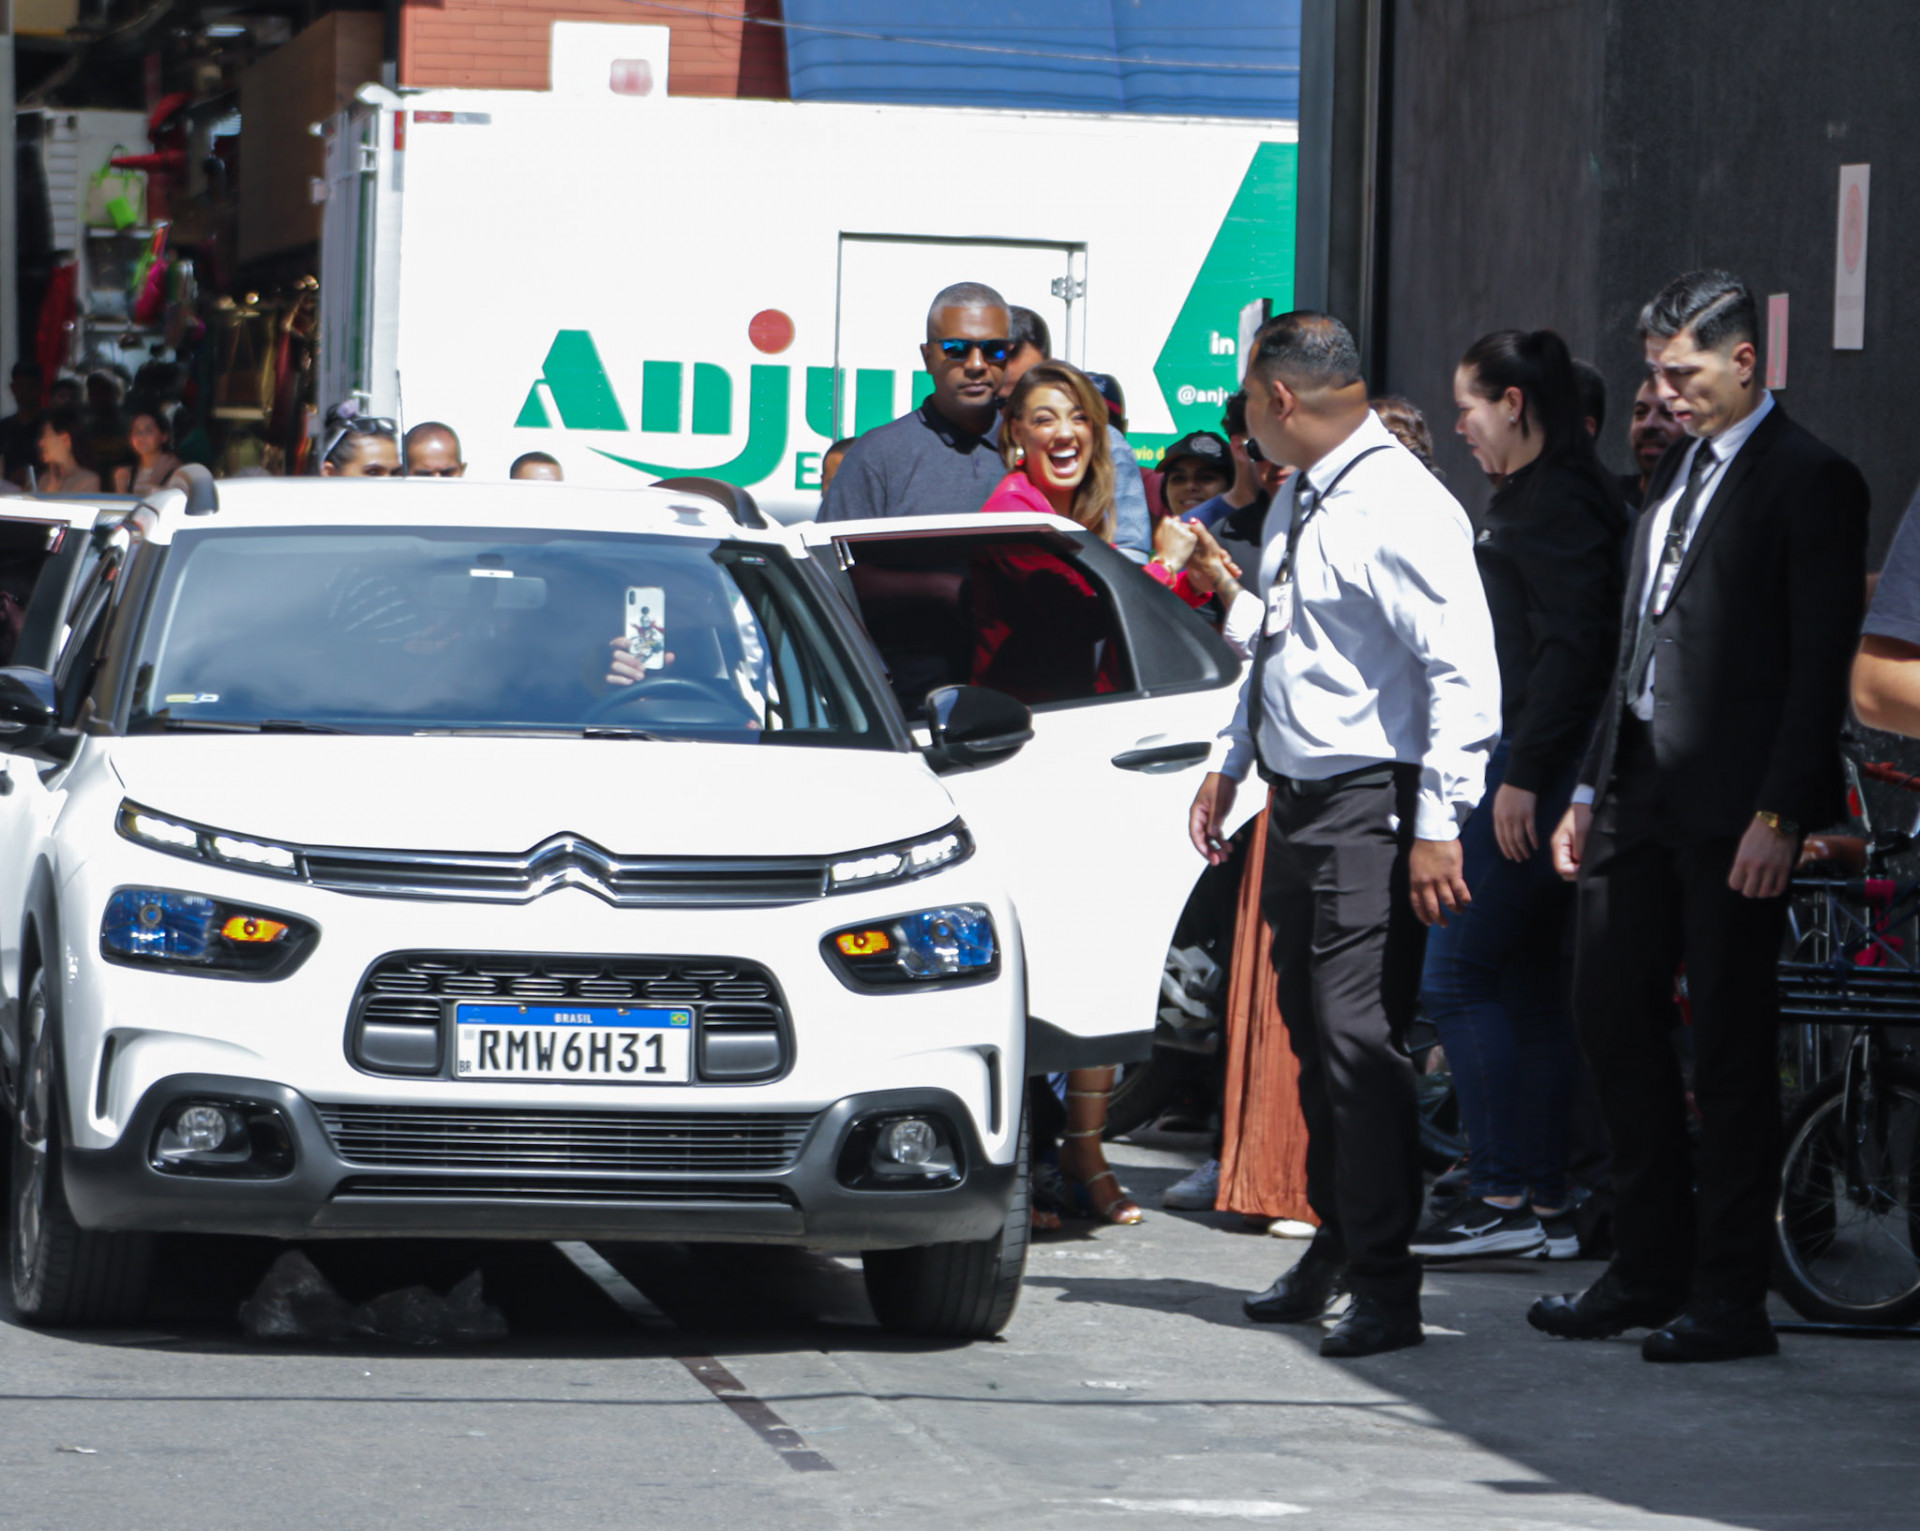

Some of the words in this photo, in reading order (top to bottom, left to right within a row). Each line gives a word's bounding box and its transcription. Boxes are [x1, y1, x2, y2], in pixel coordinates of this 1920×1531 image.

[1210, 332, 1235, 355] in
[513, 308, 936, 488] Anju
[1135, 445, 1154, 461] vio
[795, 452, 823, 490] E
[554, 1013, 593, 1024] BRASIL
[478, 1029, 666, 1074] RMW6H31
[459, 1060, 472, 1073] BR
